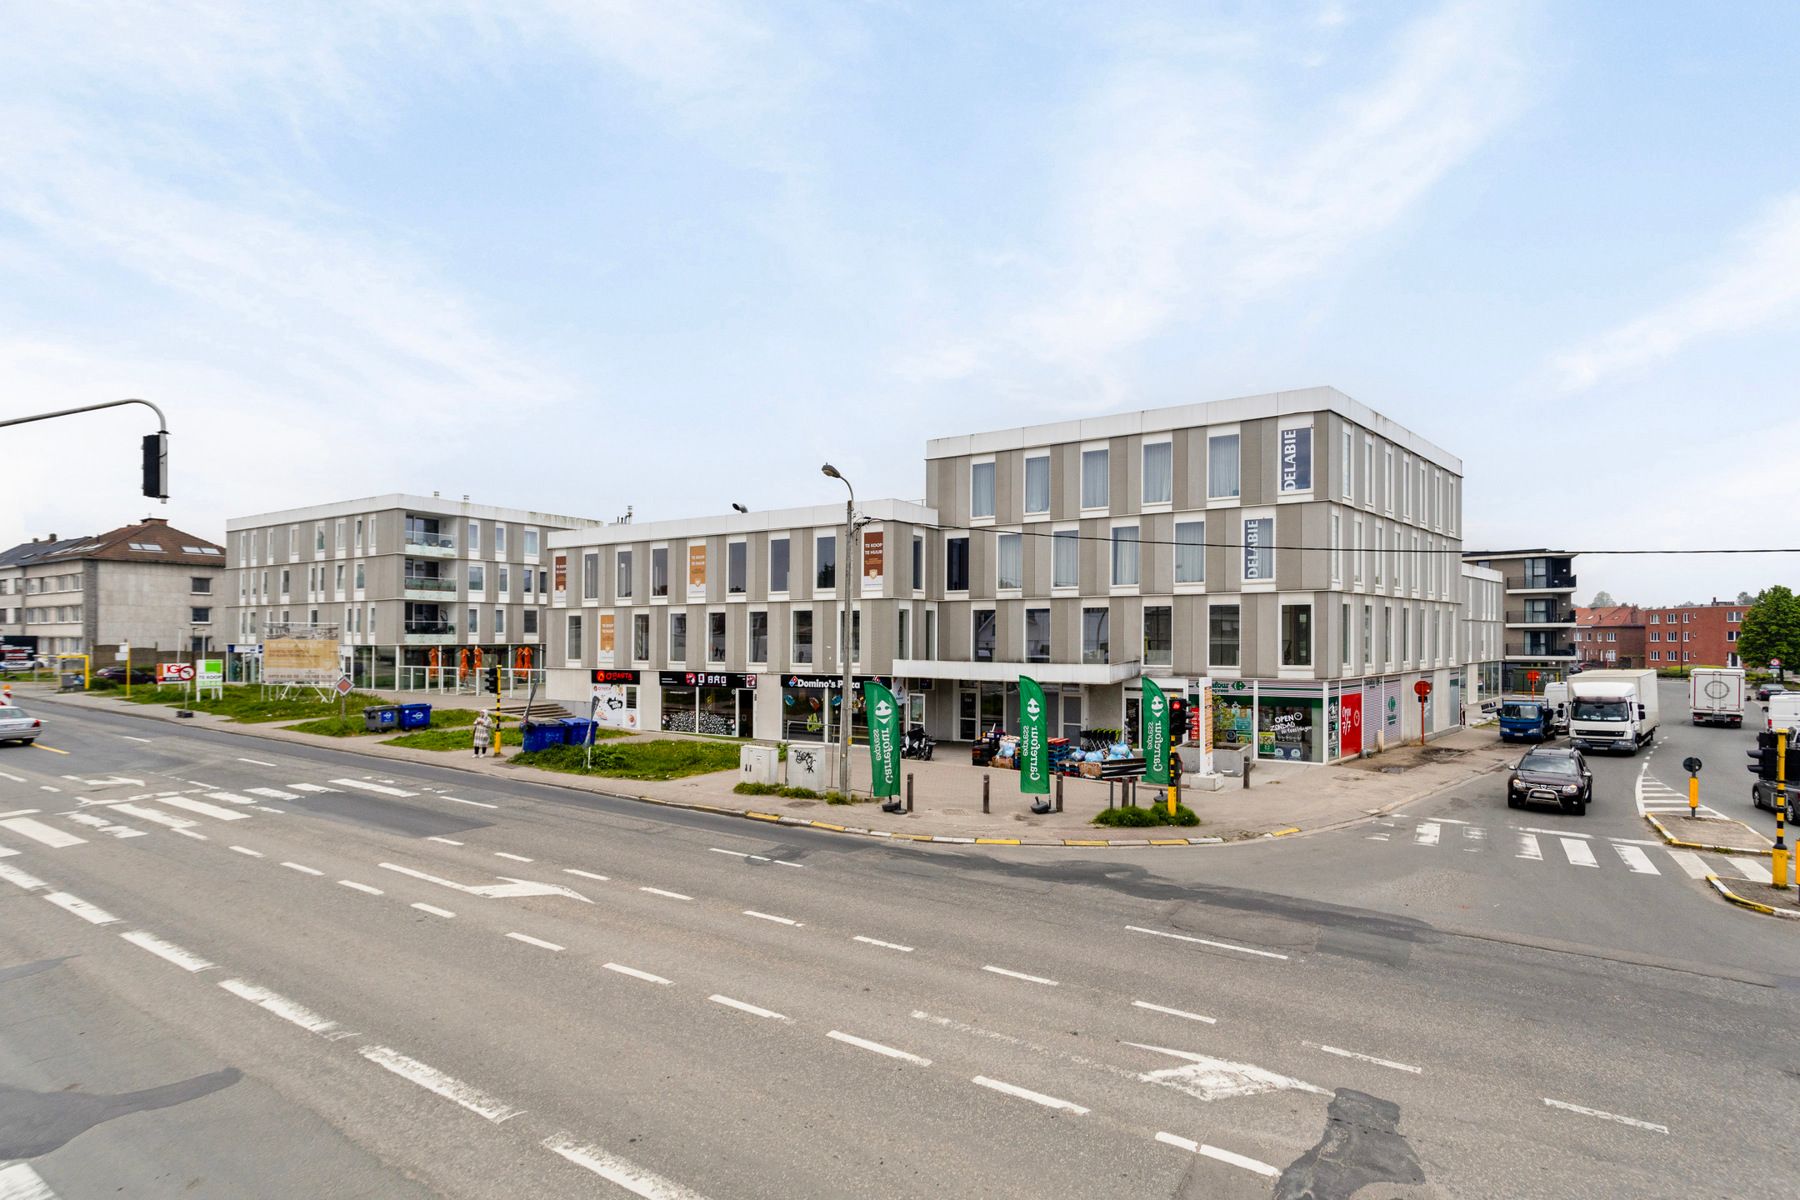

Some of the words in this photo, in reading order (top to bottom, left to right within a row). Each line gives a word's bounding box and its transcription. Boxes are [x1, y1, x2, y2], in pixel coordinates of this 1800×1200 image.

[1284, 429, 1296, 491] DELABIE
[1247, 520, 1259, 578] DELABIE
[797, 678, 836, 689] Domino's
[1274, 714, 1295, 724] OPEN
